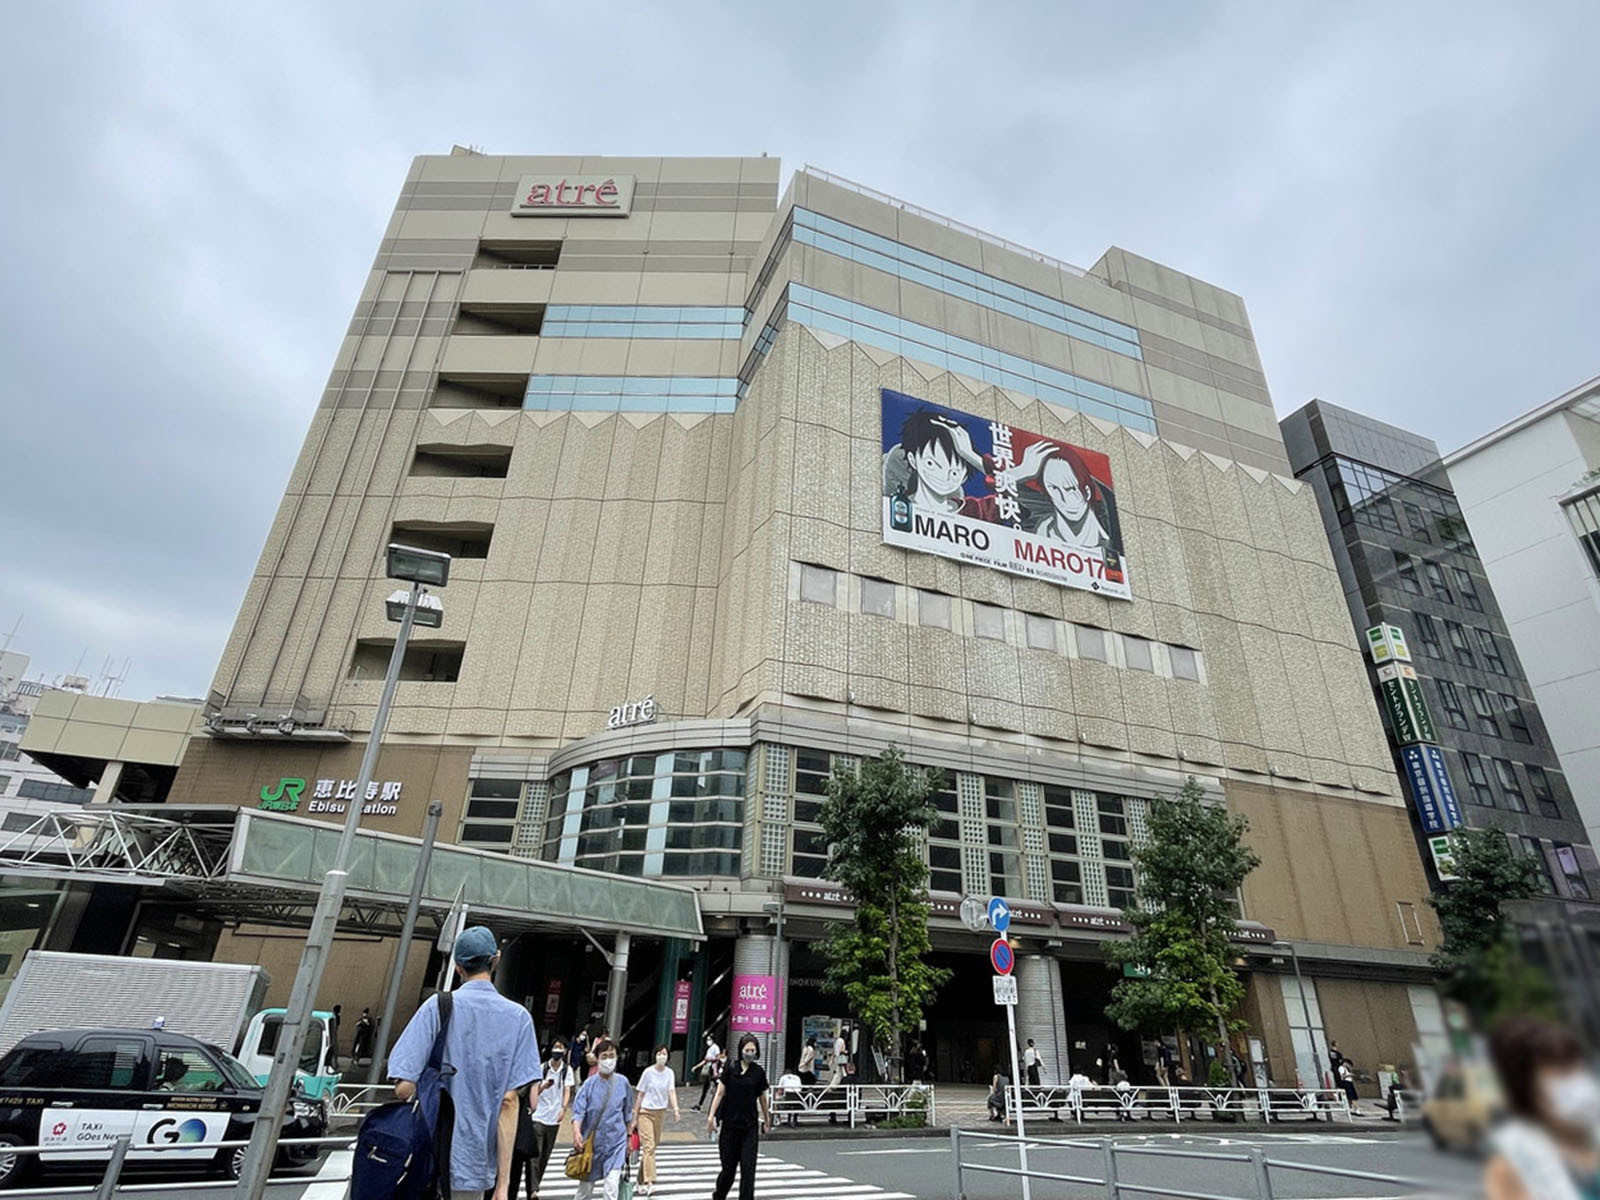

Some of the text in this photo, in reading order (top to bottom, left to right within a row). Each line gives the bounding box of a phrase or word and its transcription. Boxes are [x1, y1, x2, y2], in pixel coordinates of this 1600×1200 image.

[526, 178, 618, 206] atré
[915, 514, 990, 551] MARO
[1014, 538, 1105, 580] MARO17
[608, 694, 654, 728] atré
[260, 777, 305, 801] JR
[308, 800, 346, 813] Ebisu
[739, 984, 768, 1000] atré
